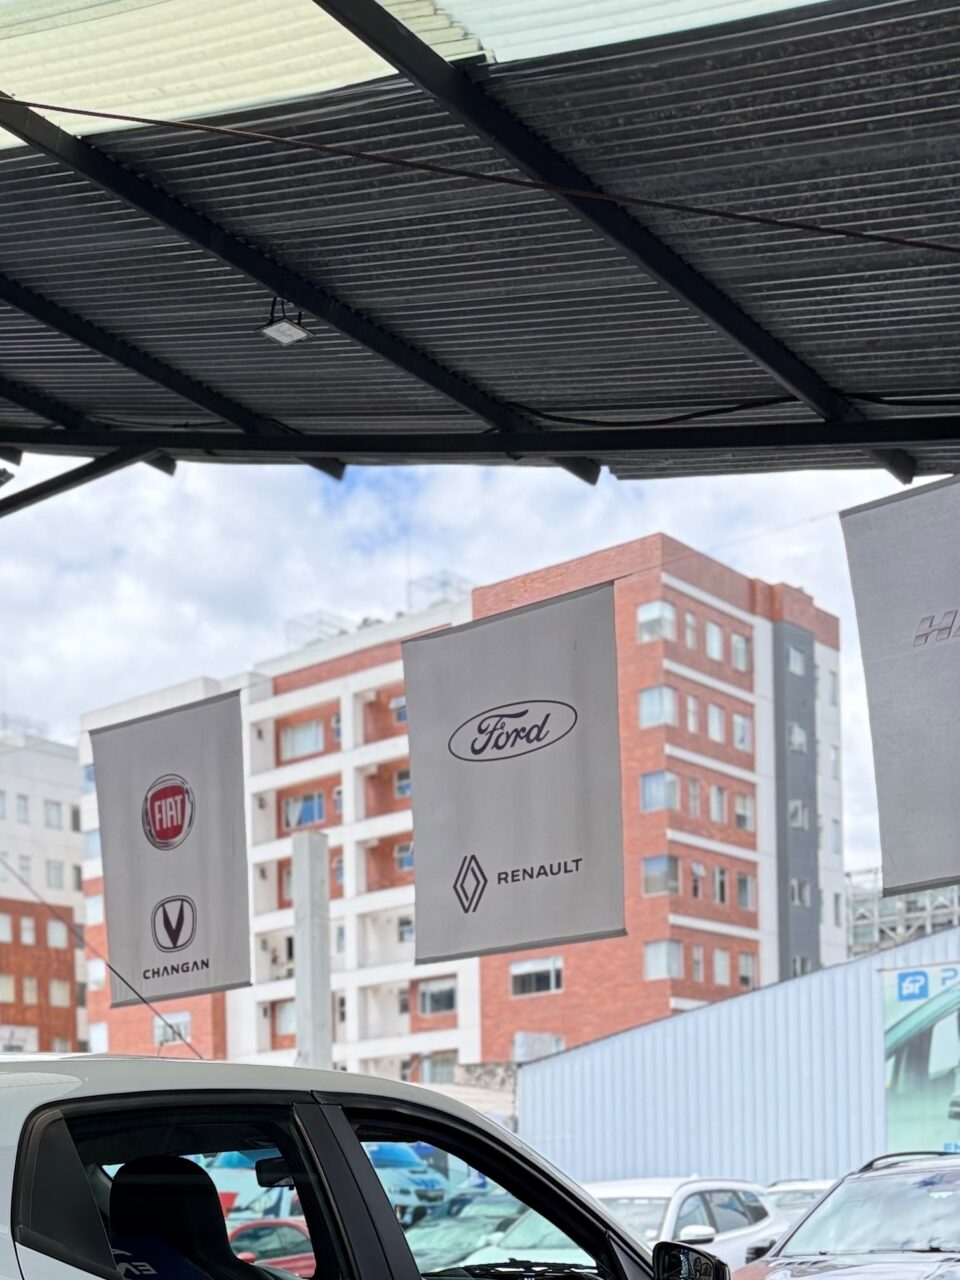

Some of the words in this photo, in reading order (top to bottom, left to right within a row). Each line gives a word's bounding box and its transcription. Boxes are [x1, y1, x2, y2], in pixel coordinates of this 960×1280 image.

[470, 709, 551, 756] Ford
[154, 794, 183, 831] FIAT
[497, 858, 583, 885] RENAULT
[143, 958, 210, 980] CHANGAN
